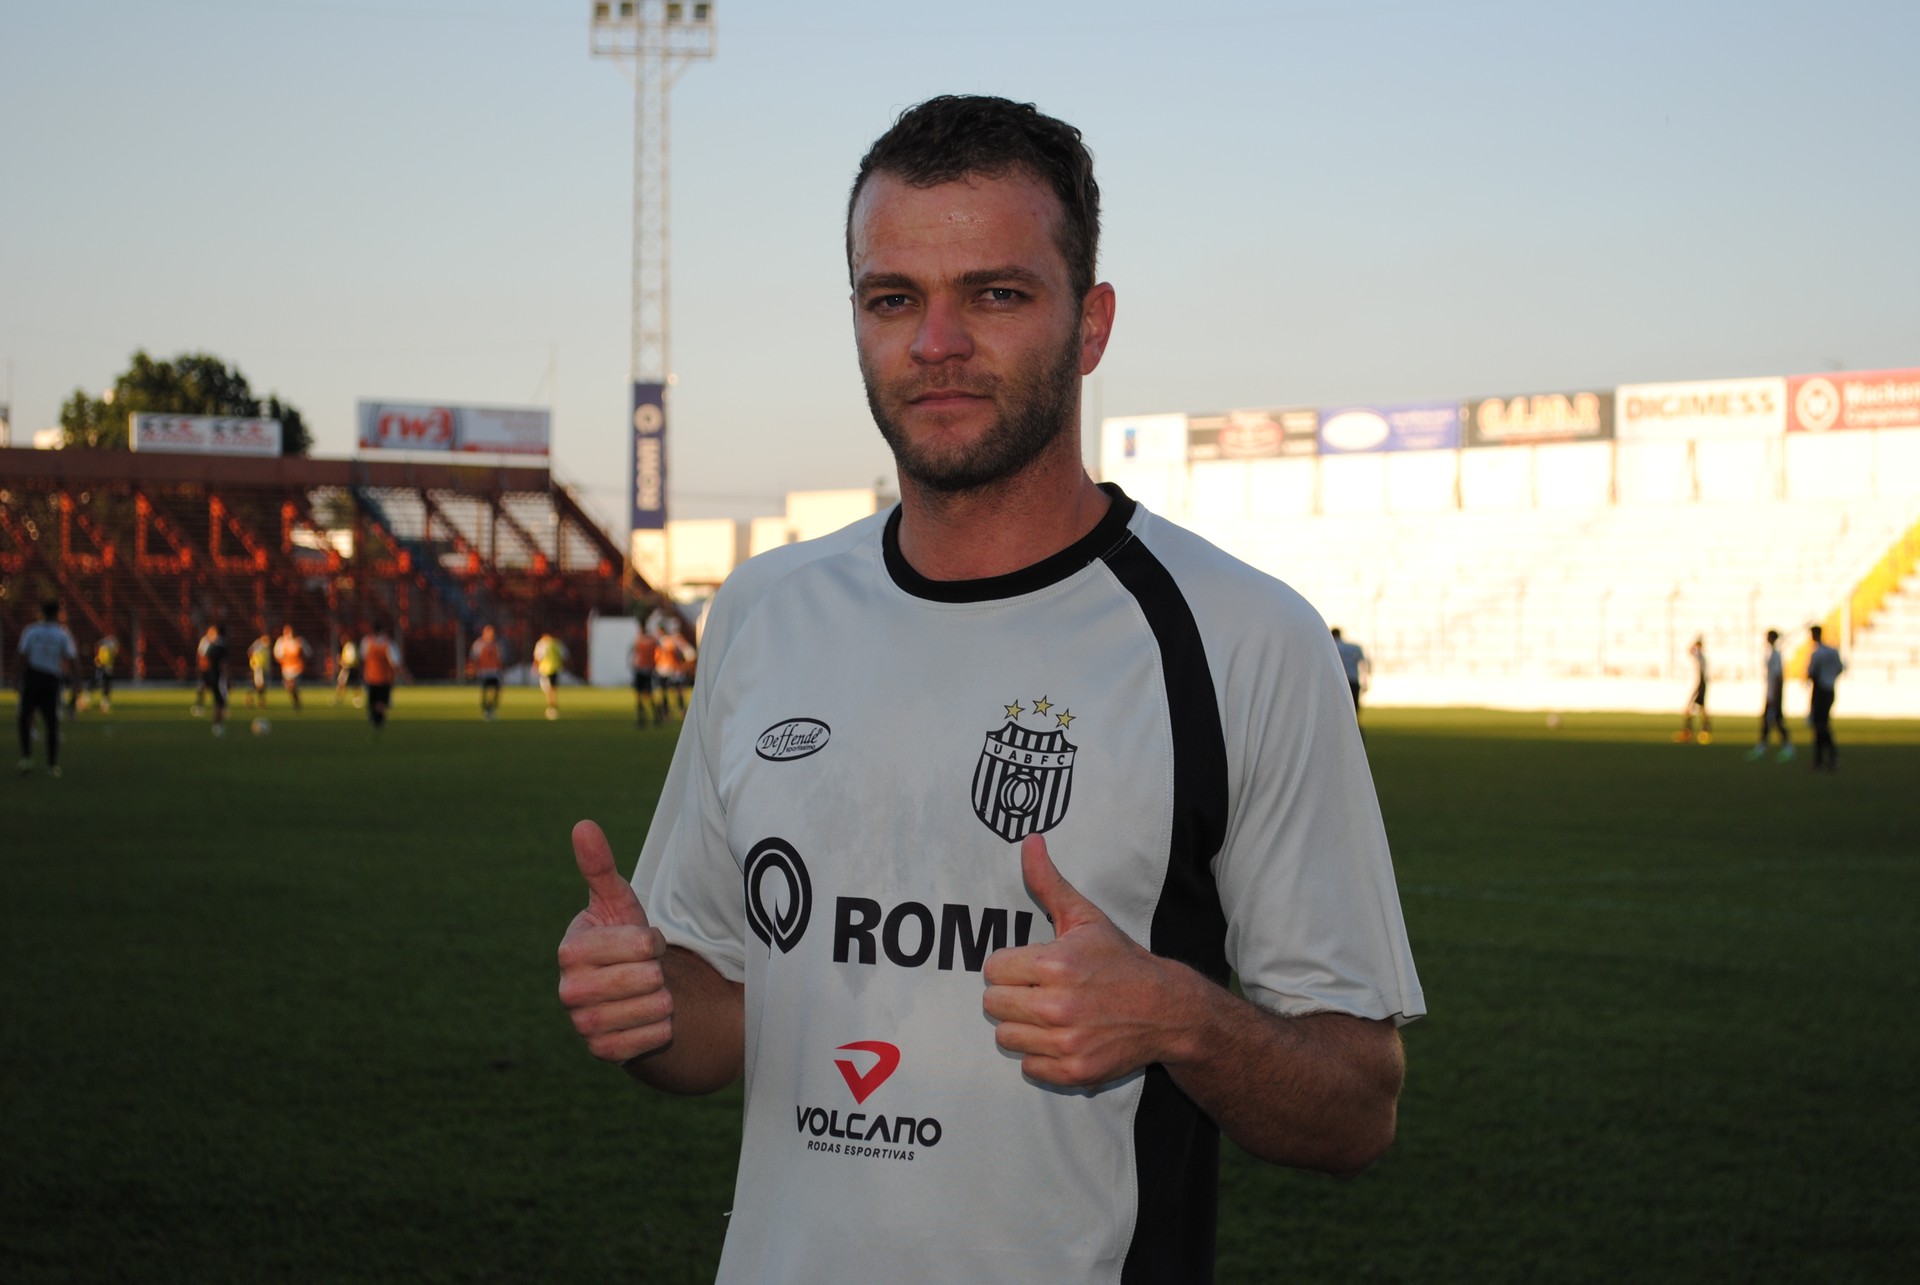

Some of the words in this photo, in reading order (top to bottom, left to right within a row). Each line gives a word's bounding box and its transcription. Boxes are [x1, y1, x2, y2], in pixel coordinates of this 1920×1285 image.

[1625, 391, 1775, 421] DIGIMESS
[797, 1105, 942, 1147] VOLCANO
[807, 1140, 841, 1153] RODAS
[844, 1145, 915, 1160] ESPORTIVAS
